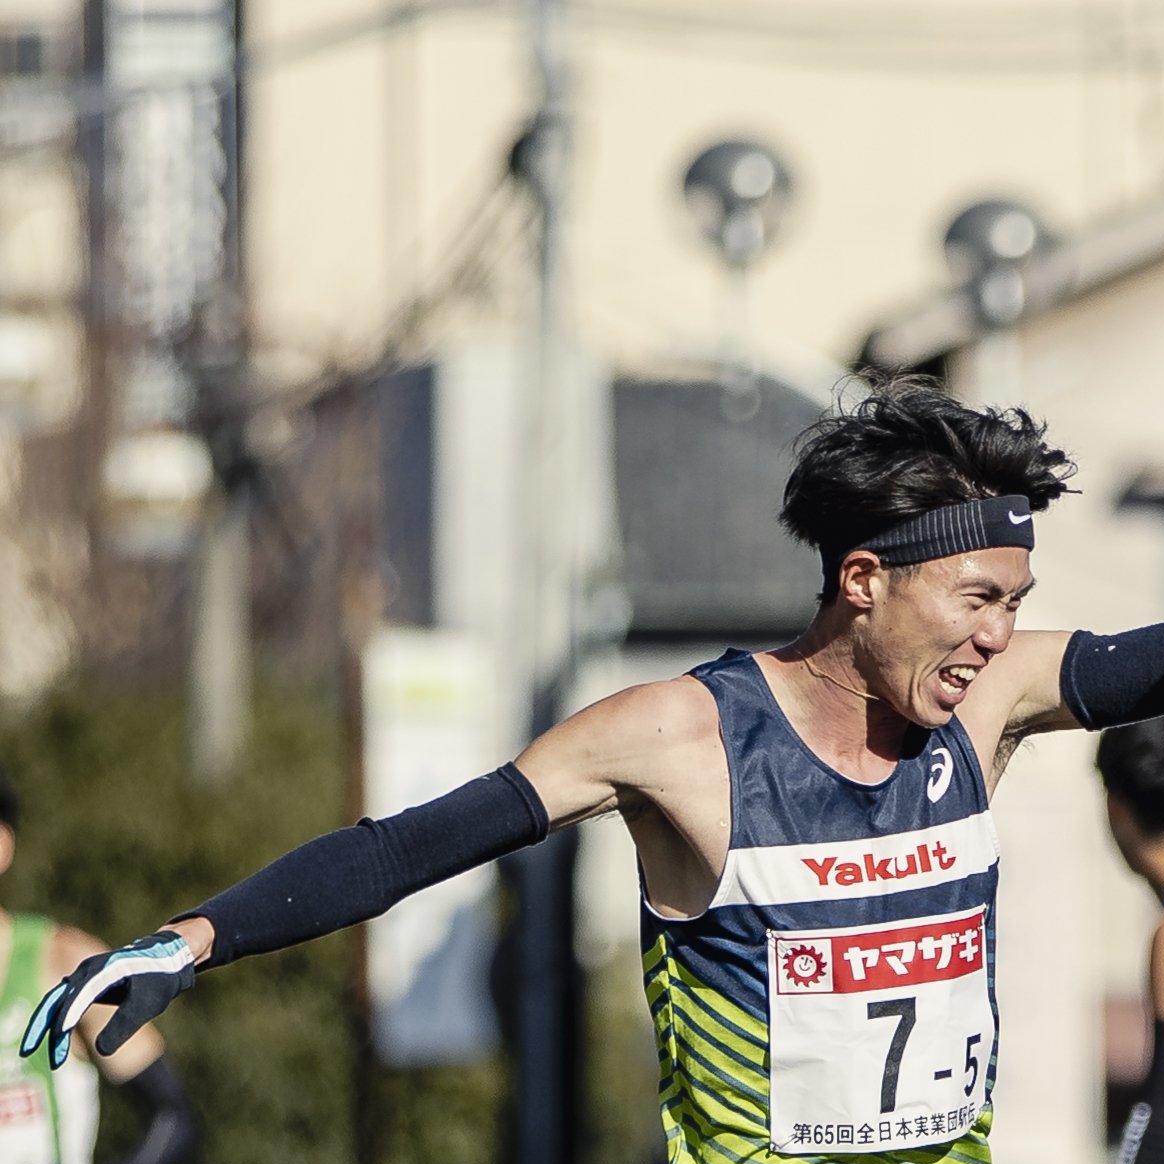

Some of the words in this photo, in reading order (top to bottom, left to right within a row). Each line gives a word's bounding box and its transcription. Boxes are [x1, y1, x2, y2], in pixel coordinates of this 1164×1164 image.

[801, 840, 957, 887] Yakult
[843, 925, 984, 982] ヤマザキ
